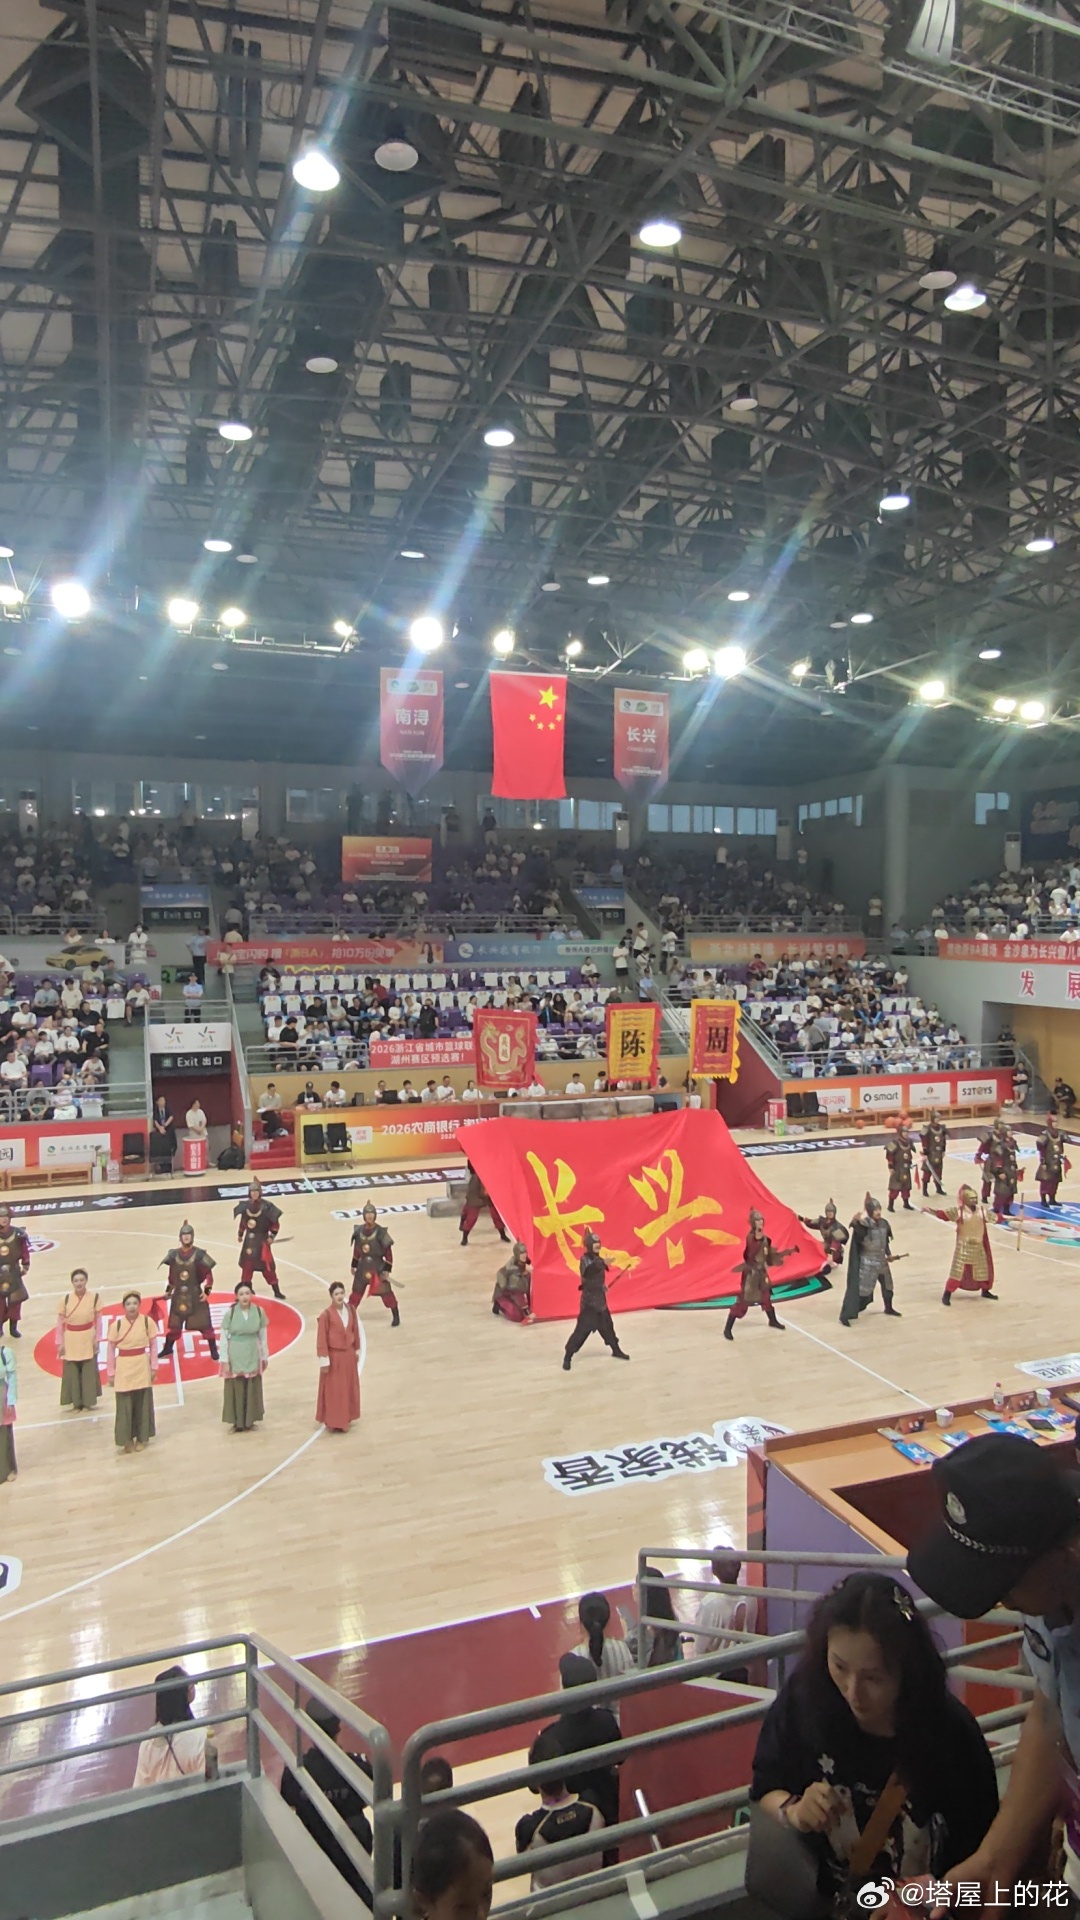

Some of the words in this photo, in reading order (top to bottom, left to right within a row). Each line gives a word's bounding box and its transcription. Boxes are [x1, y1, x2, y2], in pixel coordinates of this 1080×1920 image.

[395, 708, 430, 726] 南浔
[626, 726, 657, 744] 长兴
[1003, 943, 1080, 960] 金沙泉为长兴健儿
[620, 1029, 646, 1059] 陈
[706, 1026, 728, 1054] 周
[177, 1056, 199, 1068] Exit
[202, 1056, 223, 1066] 出口
[819, 1095, 845, 1106] 宝闪购
[873, 1091, 899, 1102] smart
[380, 1119, 461, 1136] 2026农商银行
[526, 1149, 741, 1277] 长兴
